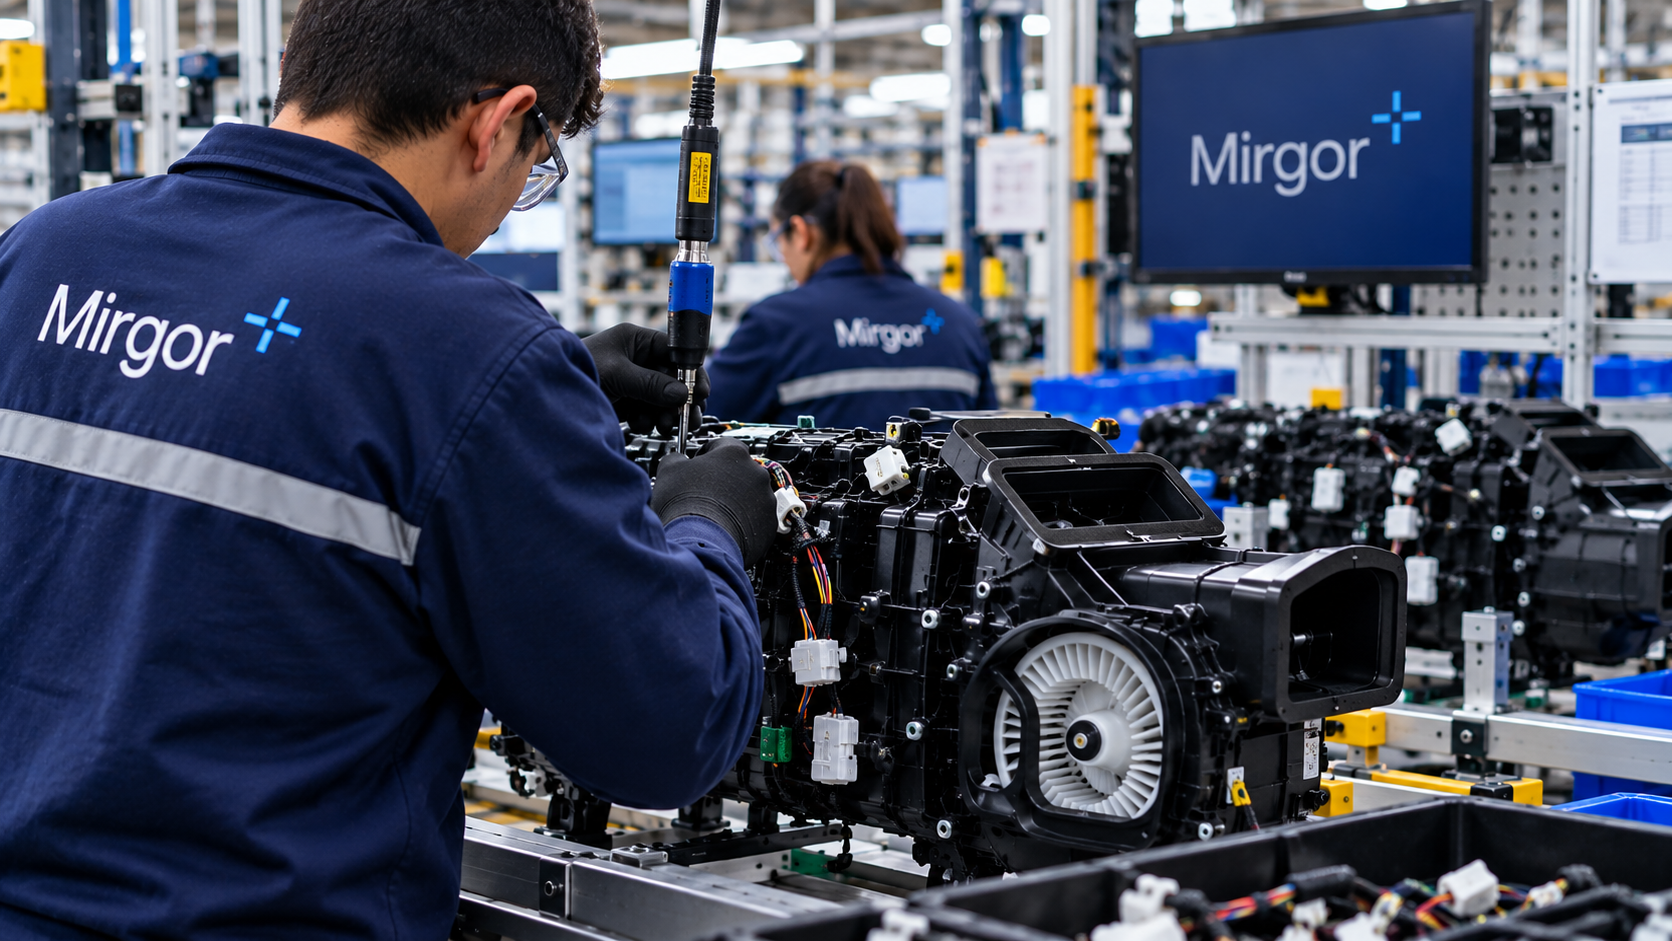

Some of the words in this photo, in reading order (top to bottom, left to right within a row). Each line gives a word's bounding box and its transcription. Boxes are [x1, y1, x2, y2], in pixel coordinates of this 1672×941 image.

[1190, 131, 1371, 197] Mirgor
[37, 283, 235, 379] Mirgor
[834, 317, 927, 354] Mirgor
